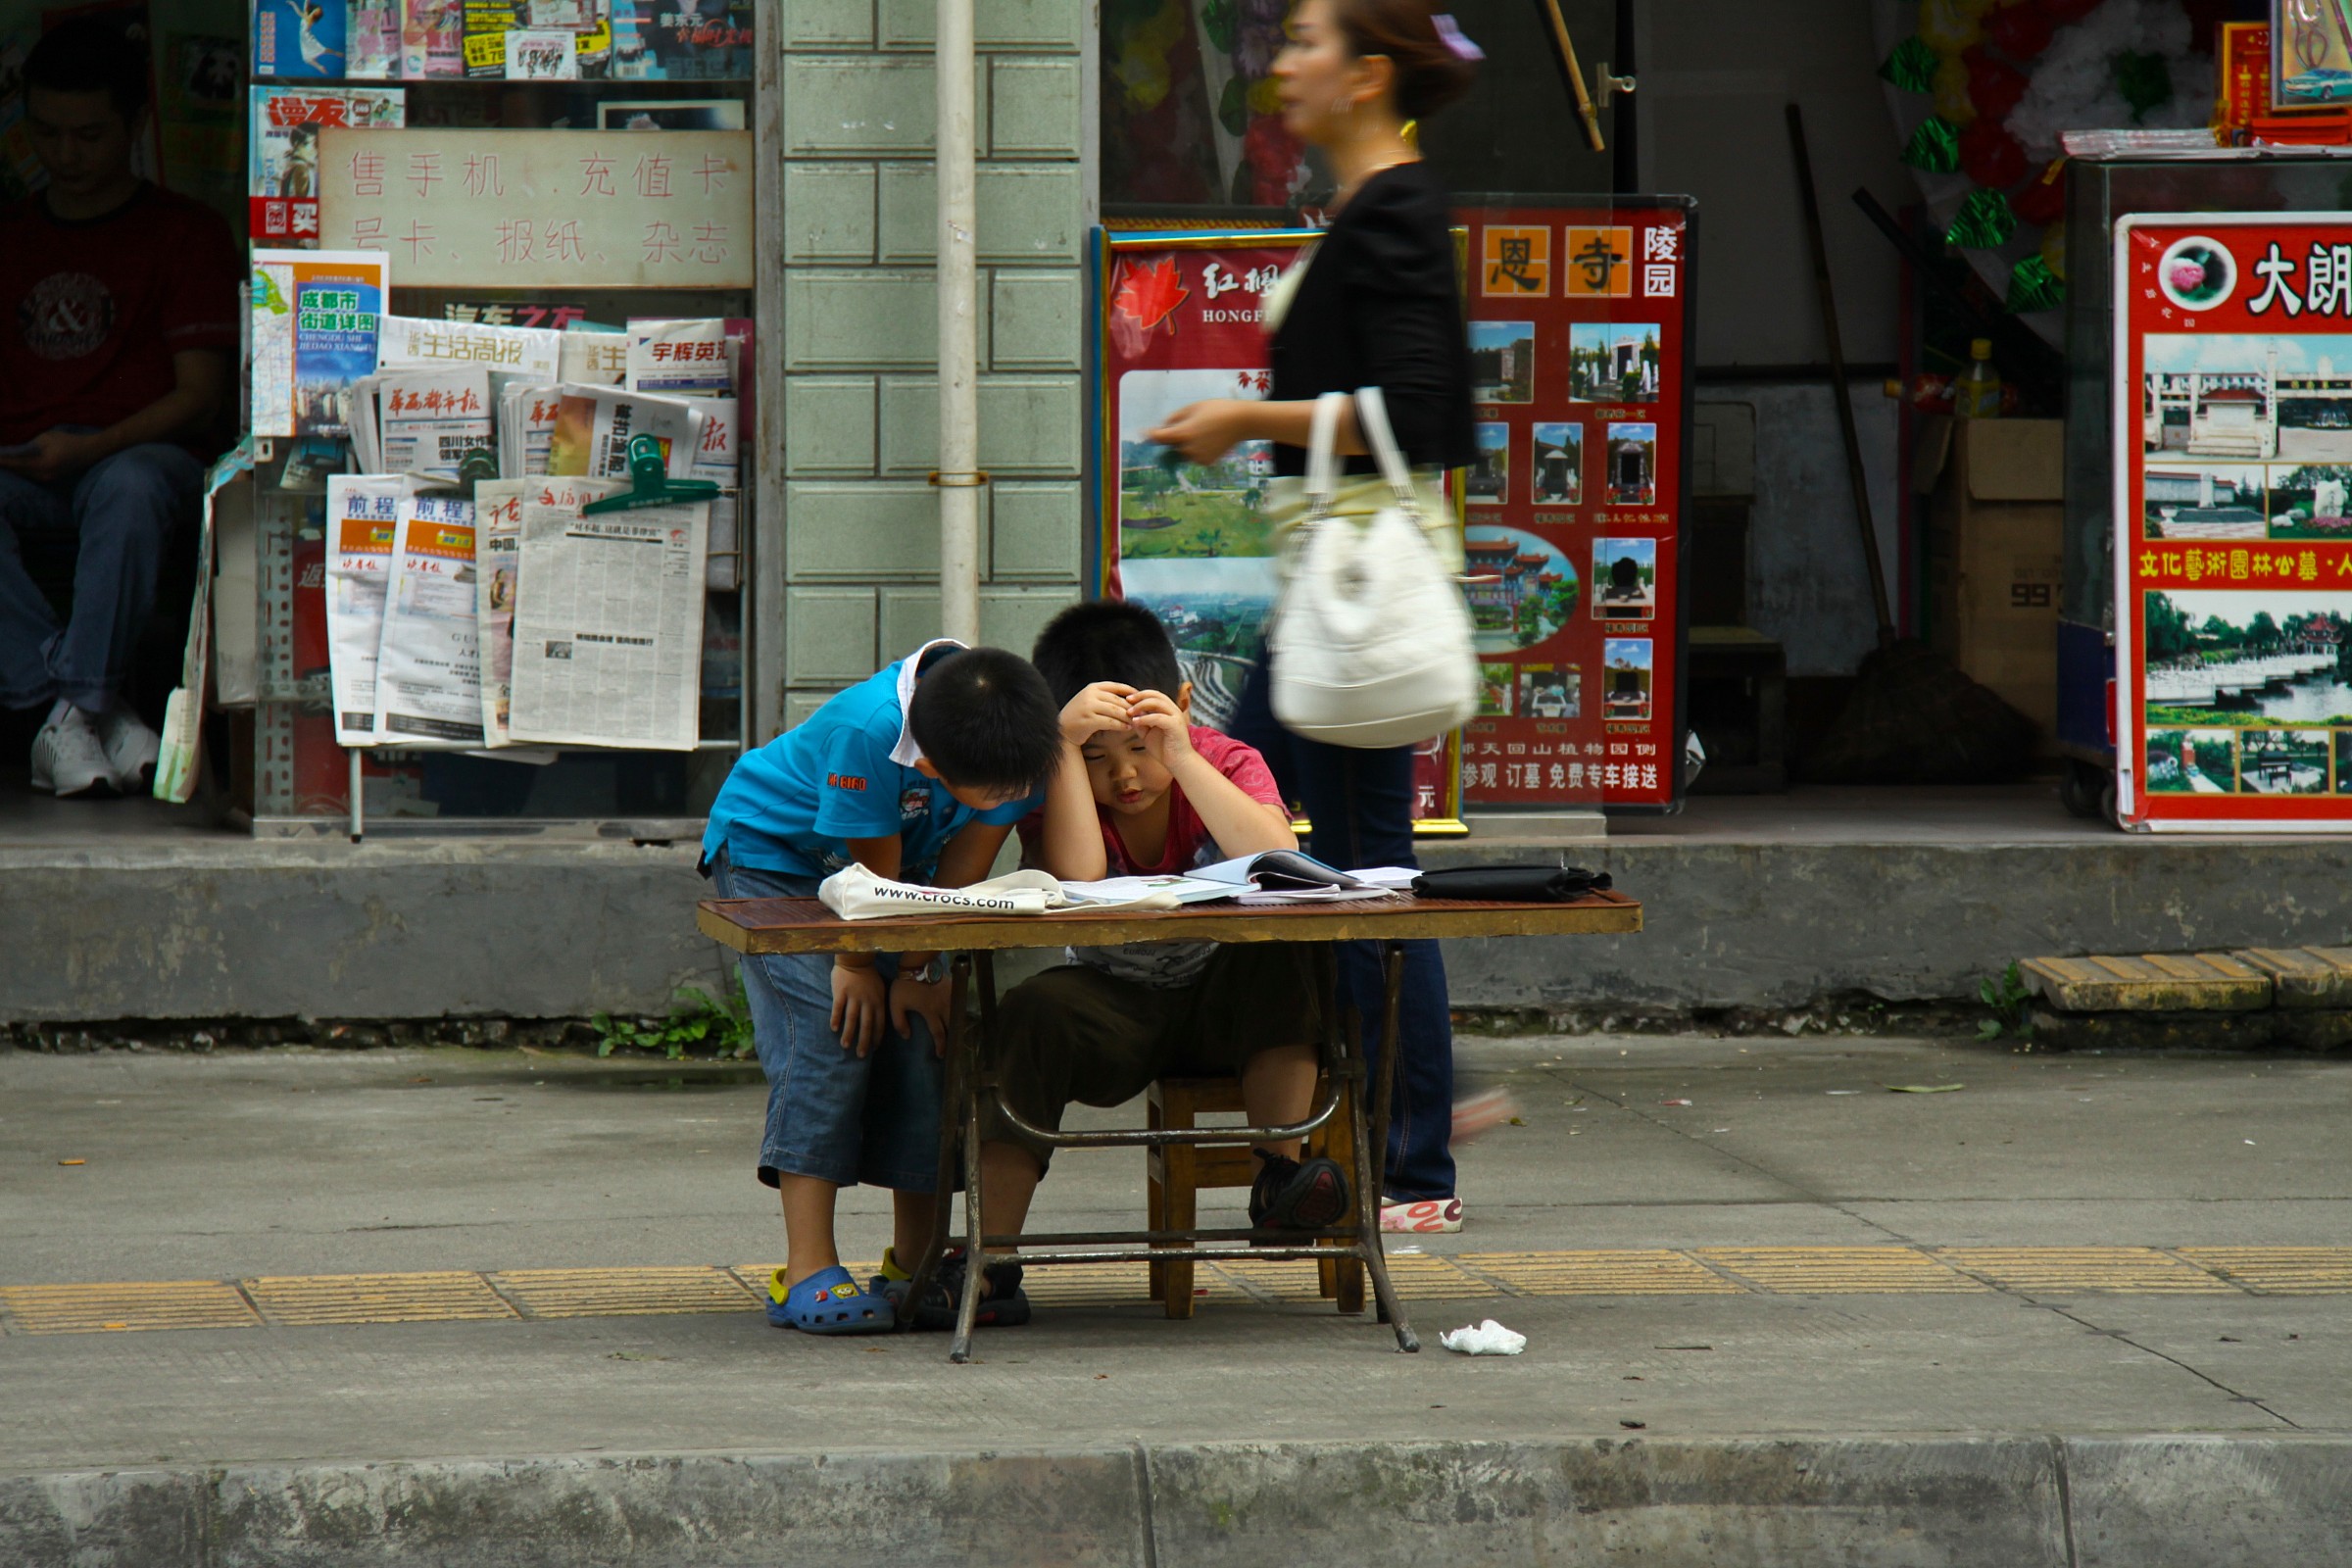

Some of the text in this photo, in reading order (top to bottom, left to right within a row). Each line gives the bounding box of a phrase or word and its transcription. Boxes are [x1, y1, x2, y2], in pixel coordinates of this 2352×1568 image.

[350, 151, 732, 198] 售手机 充值卡
[642, 220, 728, 264] 杂志
[1492, 237, 1622, 290] 恩寺
[1643, 226, 1677, 298] 陵园
[2247, 242, 2352, 316] 大朗
[299, 289, 359, 311] 成都市
[299, 312, 374, 332] 街道详图
[299, 333, 344, 342] CHENGDU
[1505, 762, 1542, 789] 订墓
[1549, 762, 1658, 789] 免费专车接送
[874, 886, 1015, 910] www.crocs.com
